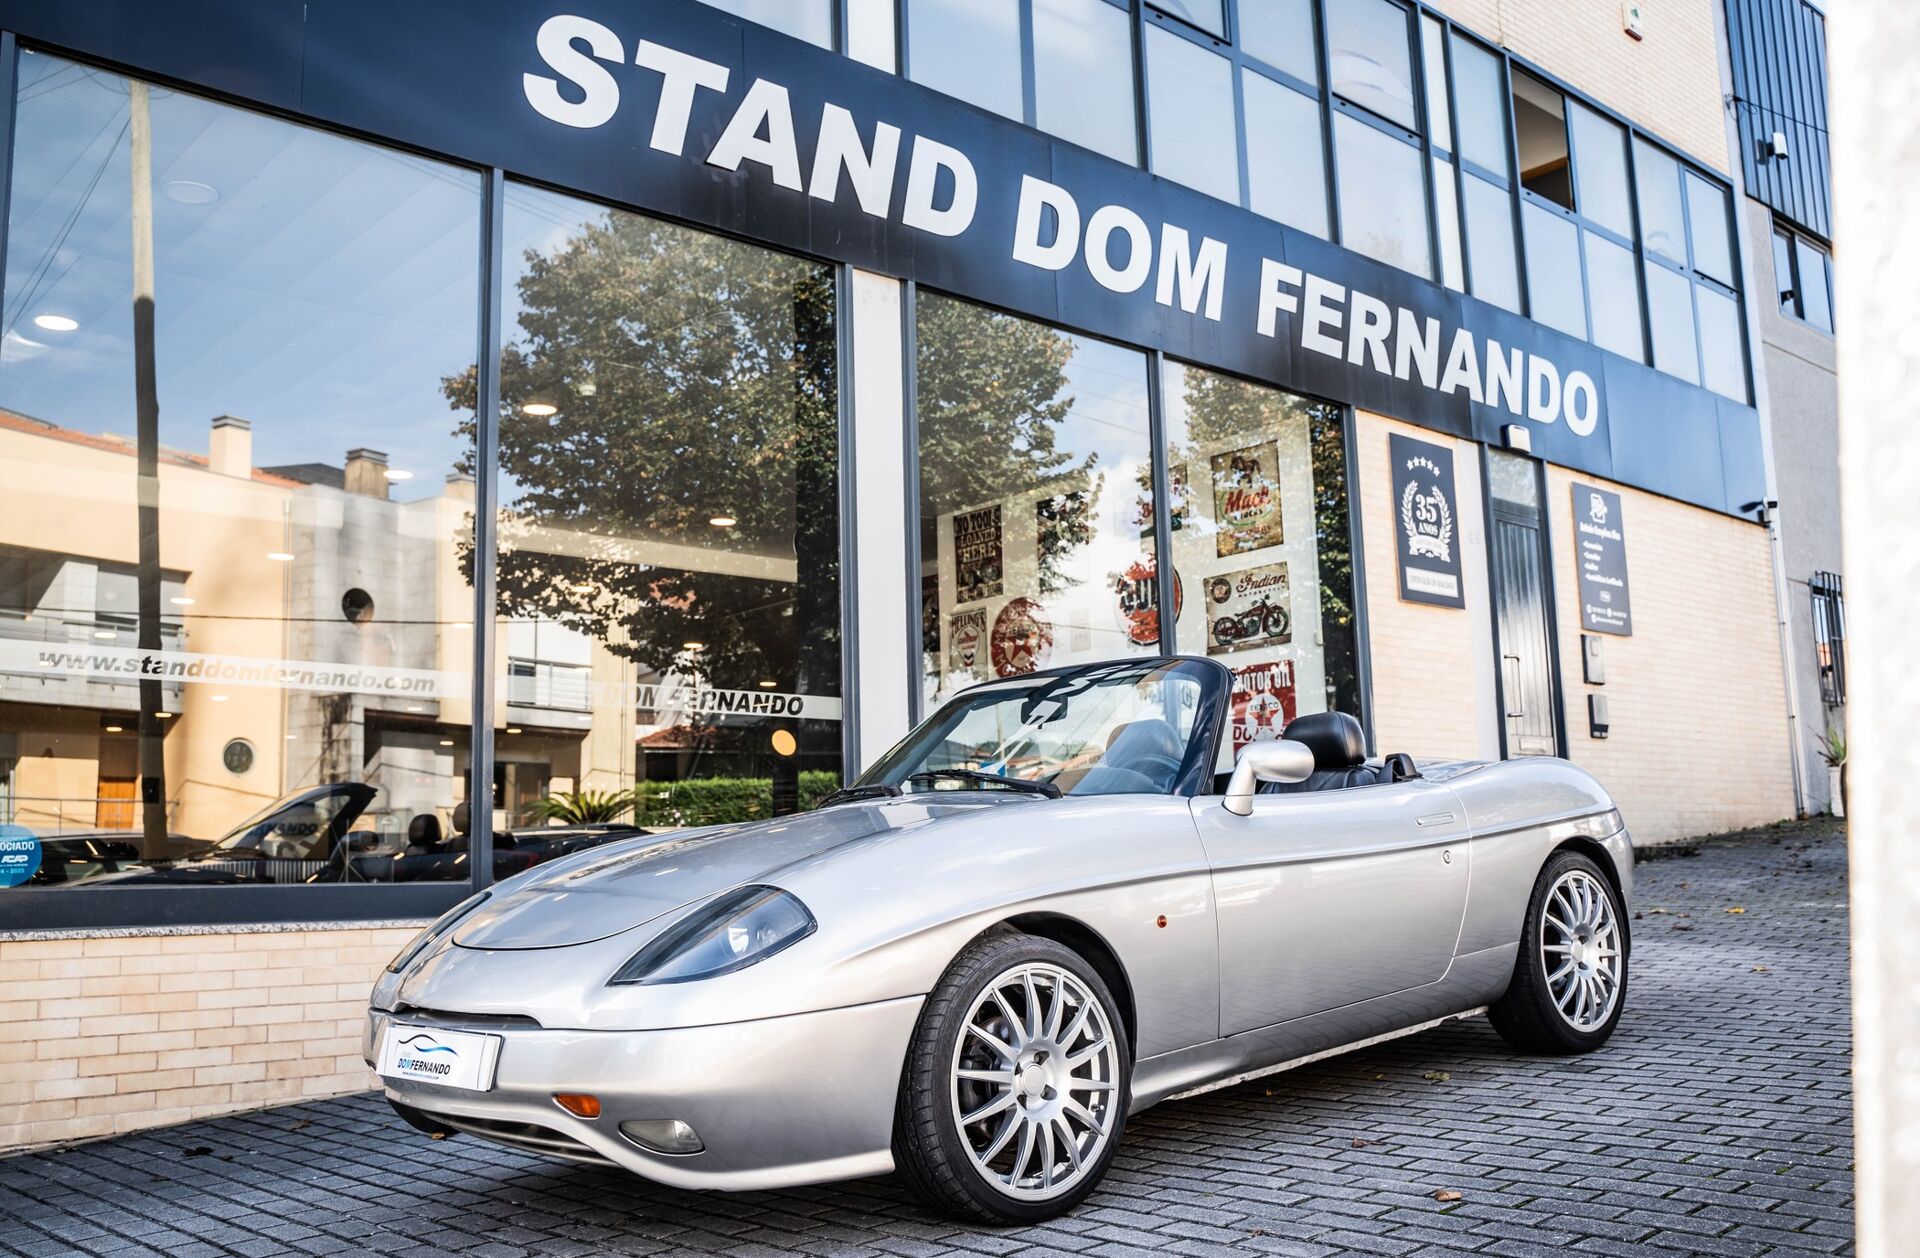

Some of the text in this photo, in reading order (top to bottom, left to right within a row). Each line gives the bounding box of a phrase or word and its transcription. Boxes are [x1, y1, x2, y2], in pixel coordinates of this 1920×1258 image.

[523, 14, 1598, 437] STAND DOM FERNANDO
[1232, 508, 1263, 521] UCKS
[1415, 494, 1437, 522] 35
[960, 528, 997, 547] LOANED
[1418, 522, 1438, 536] ANOS
[962, 541, 996, 563] HERE
[1236, 573, 1286, 593] Indian
[39, 652, 435, 692] www.standdomfernando.com
